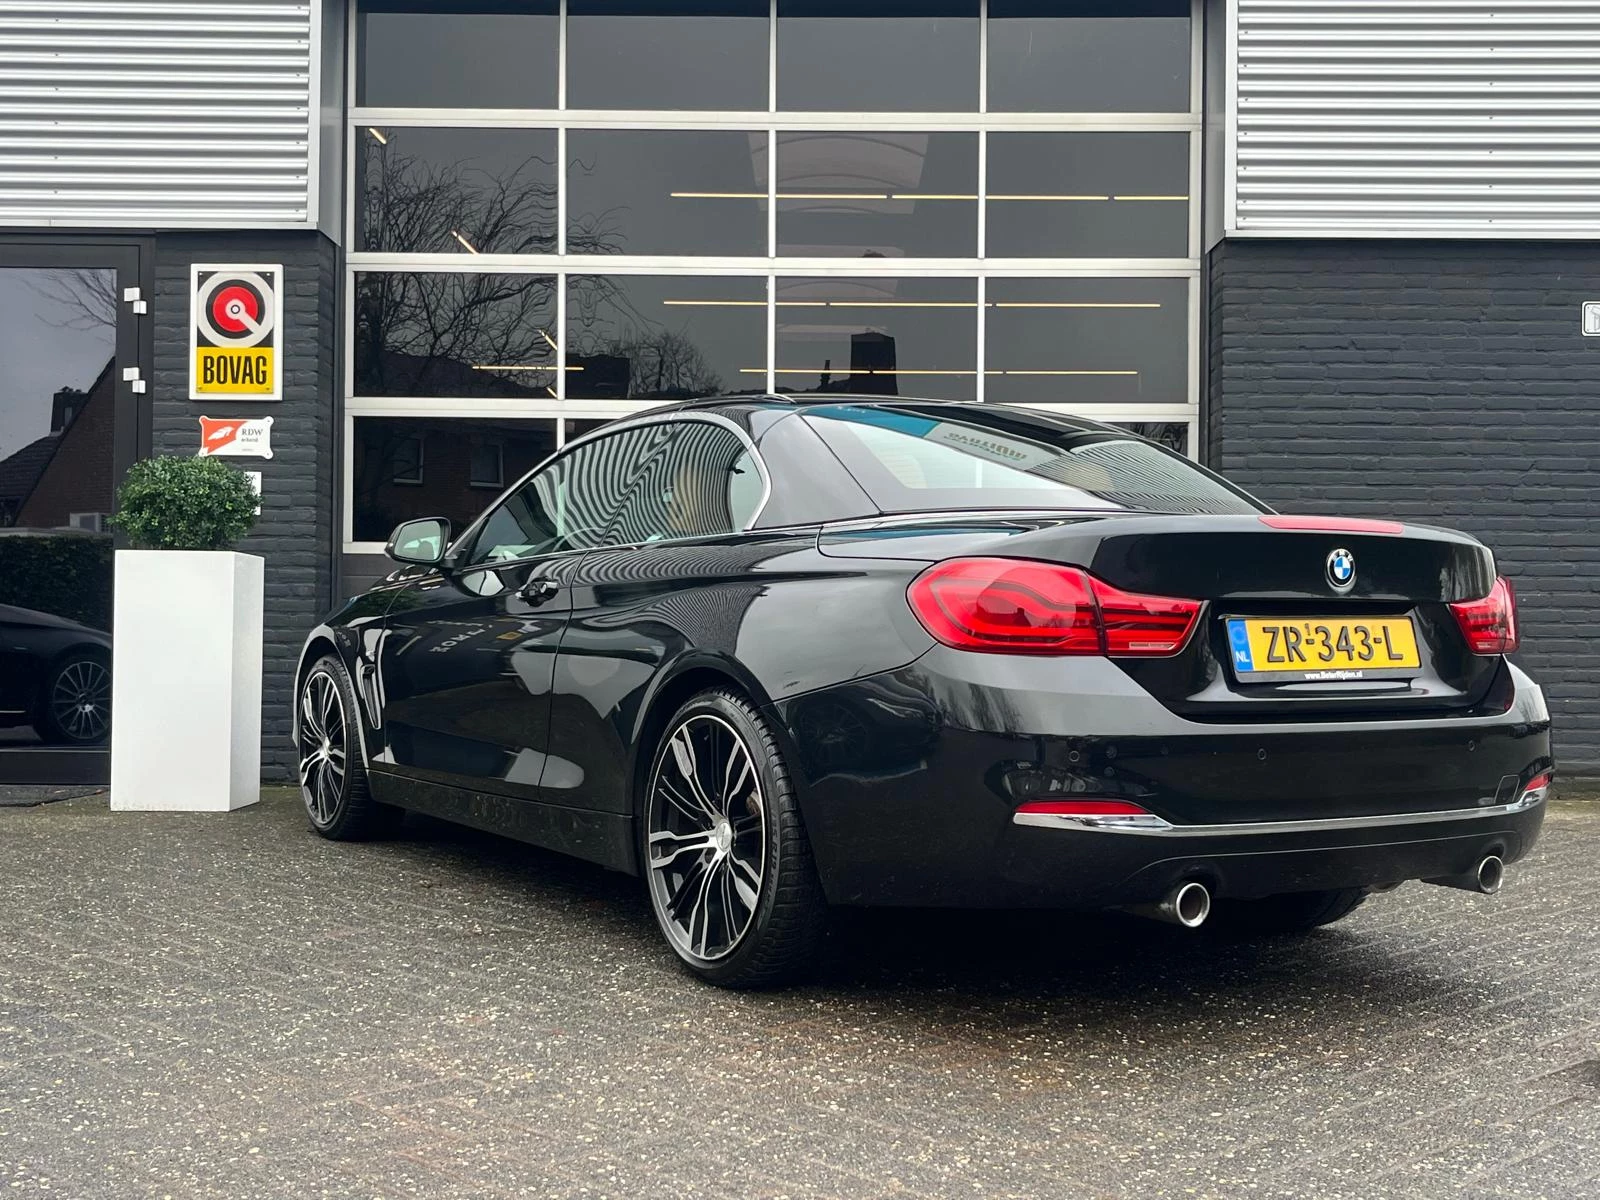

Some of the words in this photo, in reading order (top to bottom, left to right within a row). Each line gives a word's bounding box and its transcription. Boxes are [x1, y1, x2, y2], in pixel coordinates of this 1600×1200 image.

[203, 355, 267, 385] BOVAG
[241, 428, 264, 436] RDW
[1262, 626, 1404, 663] ZR-343-L
[1235, 650, 1250, 662] NL
